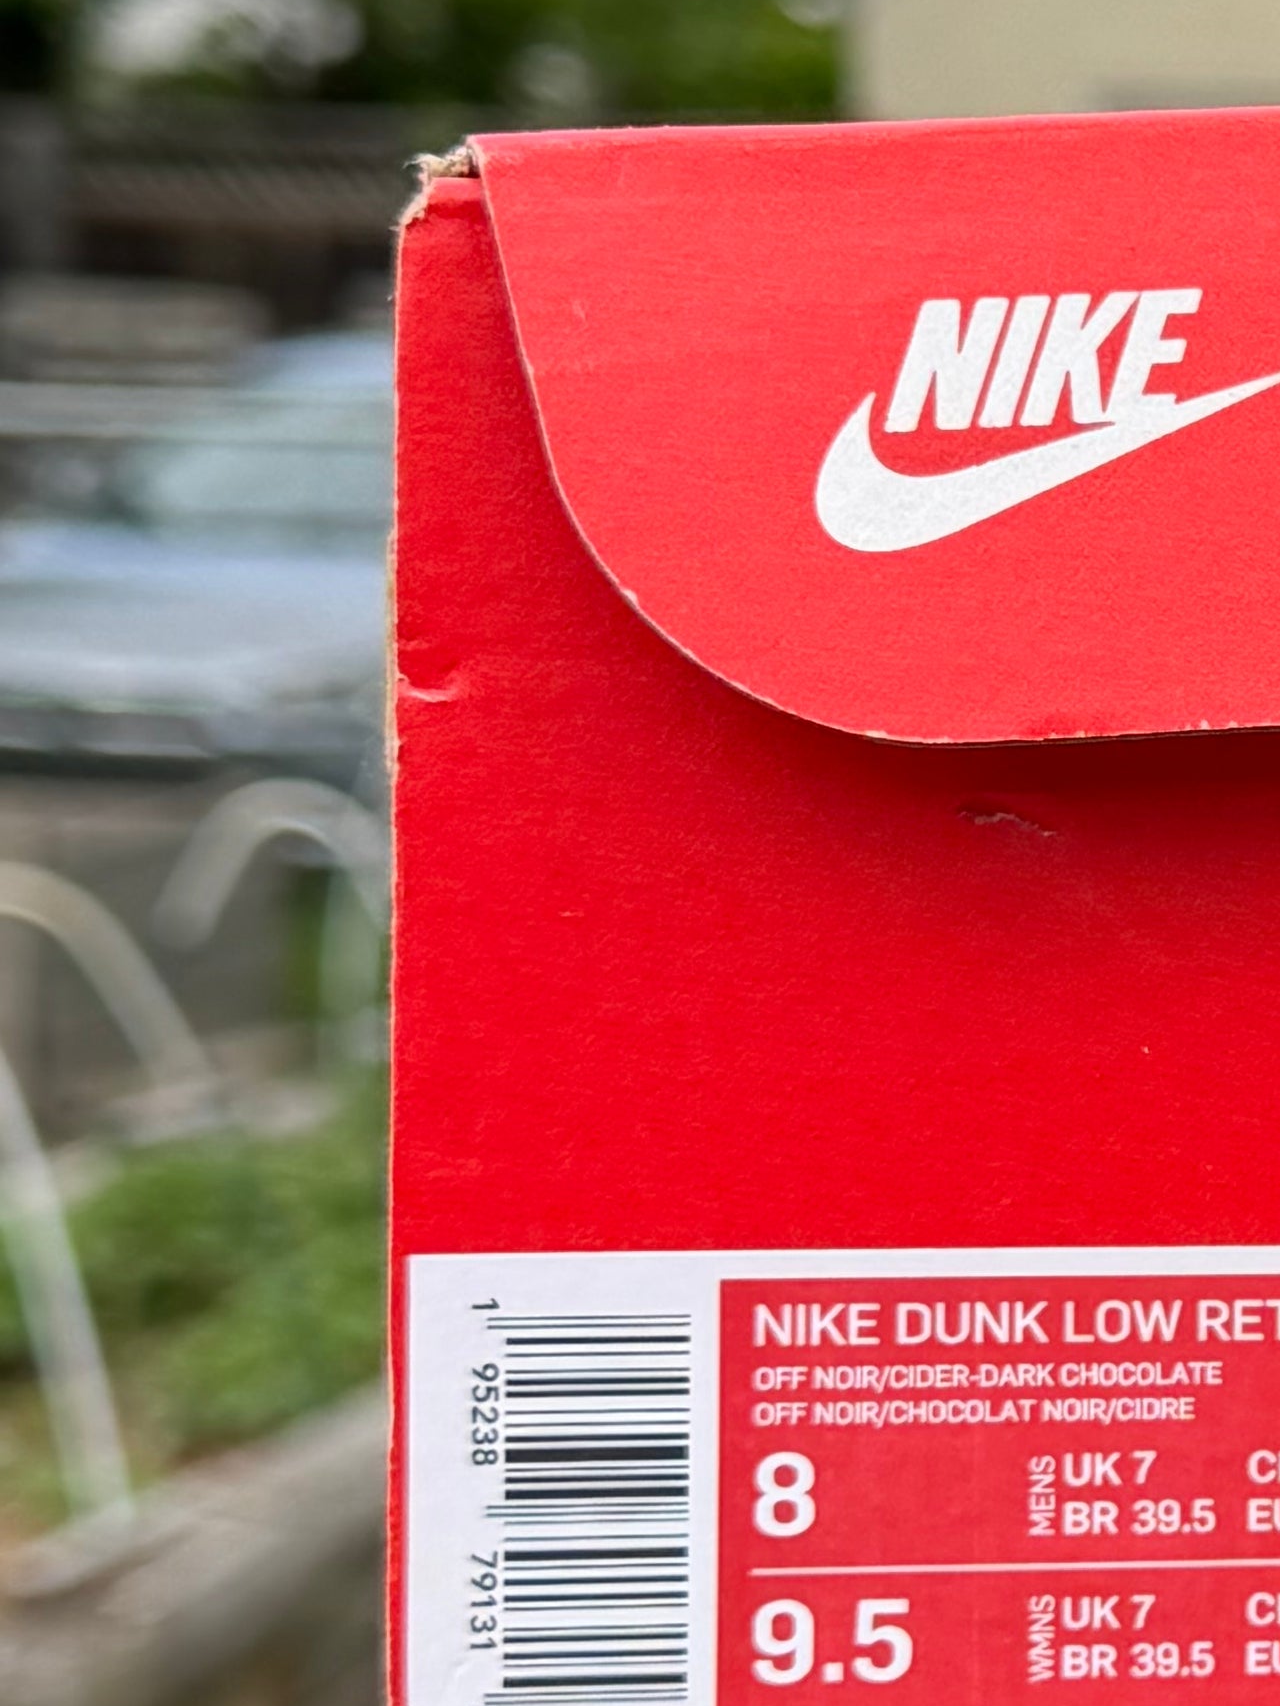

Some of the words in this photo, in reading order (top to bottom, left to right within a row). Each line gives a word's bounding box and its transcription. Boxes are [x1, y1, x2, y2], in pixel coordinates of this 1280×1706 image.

[883, 287, 1207, 436] NIKE
[471, 1298, 500, 1310] 1
[753, 1302, 881, 1347] NIKE
[895, 1300, 1049, 1346] DUNK
[1063, 1299, 1183, 1344] LOW
[752, 1365, 809, 1392] OFF
[812, 1362, 1055, 1394] NOIR/CIDER-DARK
[1058, 1360, 1223, 1388] CHOCOLATE
[471, 1362, 500, 1466] 95238
[751, 1401, 809, 1427] OFF
[811, 1398, 1038, 1429] NOIR/CHOCOLAT
[1040, 1396, 1196, 1425] NOIR/CIDRE
[1062, 1451, 1122, 1487] UK
[1131, 1449, 1157, 1485] 7
[753, 1451, 816, 1538] 8
[1028, 1455, 1056, 1537] MENS
[1062, 1500, 1119, 1536] BR
[1130, 1498, 1216, 1536] 39.5
[469, 1551, 499, 1650] 79131
[1061, 1595, 1121, 1631] UK
[1130, 1594, 1156, 1630] 7
[751, 1598, 913, 1686] 9.5
[1027, 1594, 1056, 1683] WMNS
[1060, 1643, 1118, 1680] BR
[1129, 1640, 1216, 1679] 39.5
